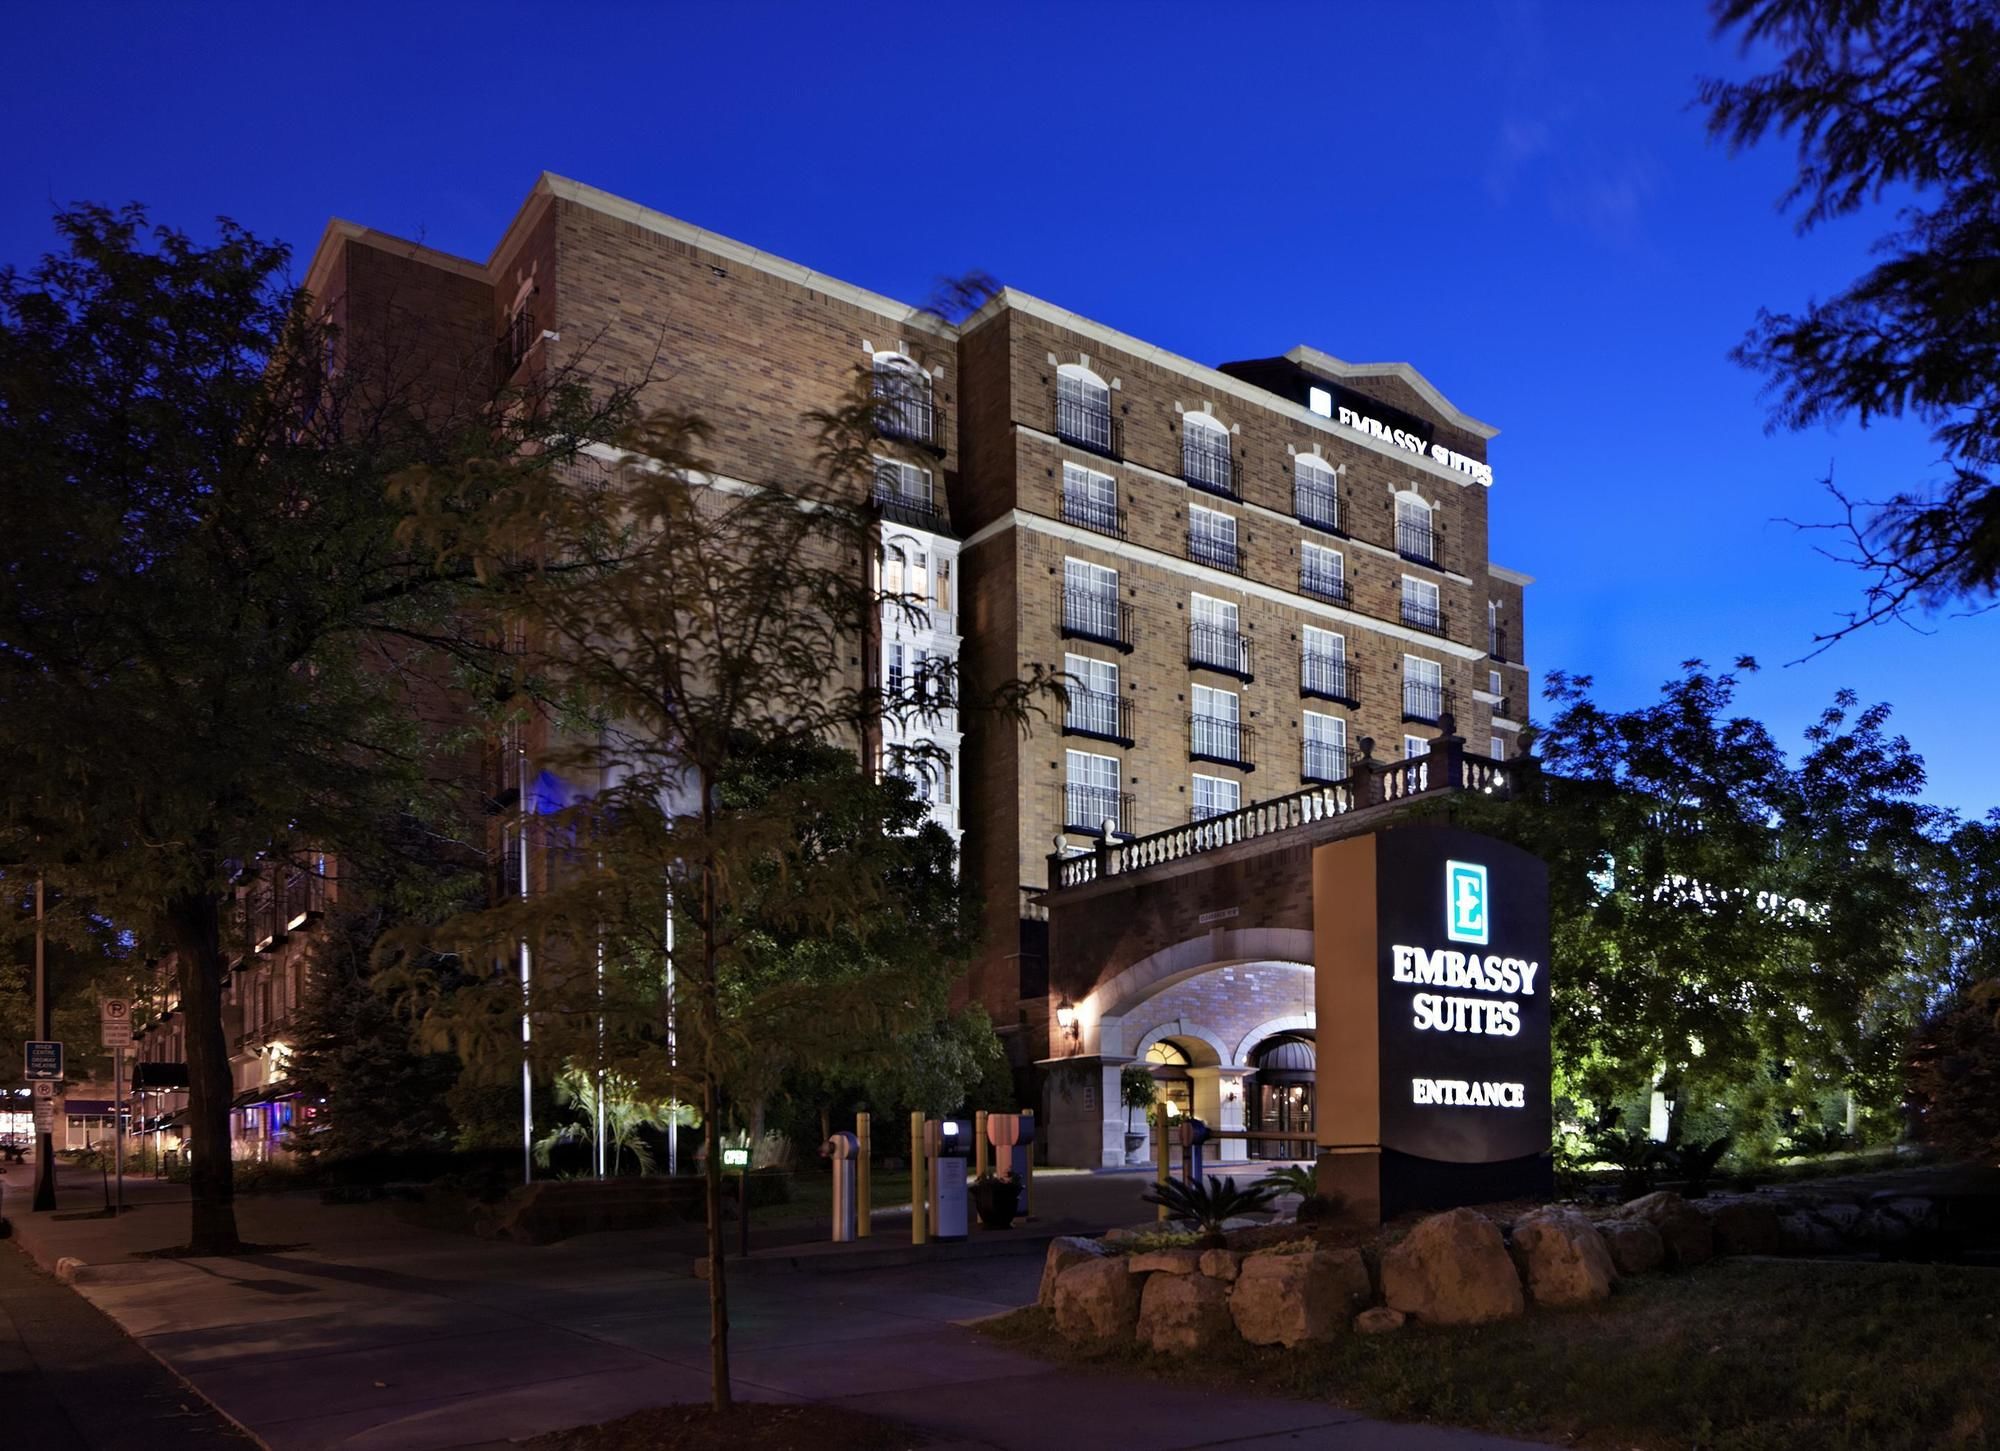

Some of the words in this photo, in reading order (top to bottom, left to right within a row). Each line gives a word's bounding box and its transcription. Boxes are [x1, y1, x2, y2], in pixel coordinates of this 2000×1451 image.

[1338, 406, 1428, 456] EMBASSY
[1431, 444, 1493, 487] SUITES
[1392, 945, 1539, 995] EMBASSY
[1413, 993, 1521, 1037] SUITES
[1412, 1078, 1525, 1108] ENTRANCE
[724, 1150, 748, 1165] OPEN
